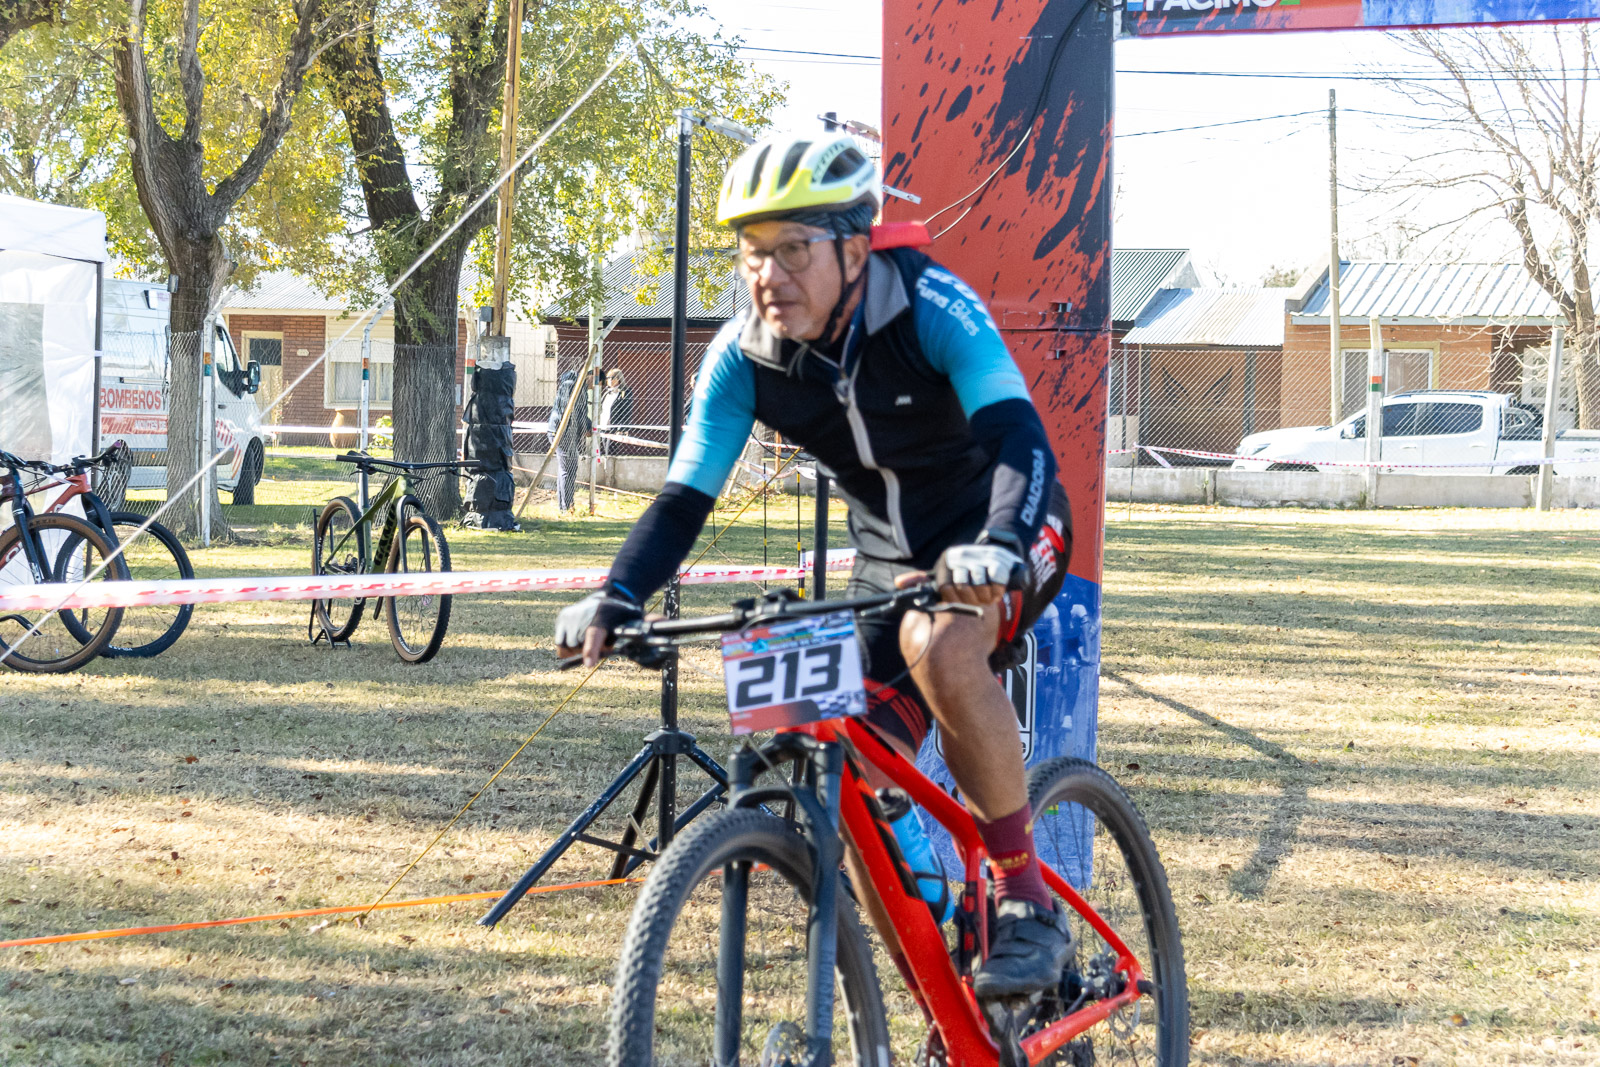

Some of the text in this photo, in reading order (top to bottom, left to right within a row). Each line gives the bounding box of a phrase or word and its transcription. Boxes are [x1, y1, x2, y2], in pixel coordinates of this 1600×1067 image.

[947, 298, 980, 336] Bikes
[100, 388, 162, 410] BOMBEROS
[1020, 448, 1046, 527] DIADORA
[735, 643, 842, 708] 213
